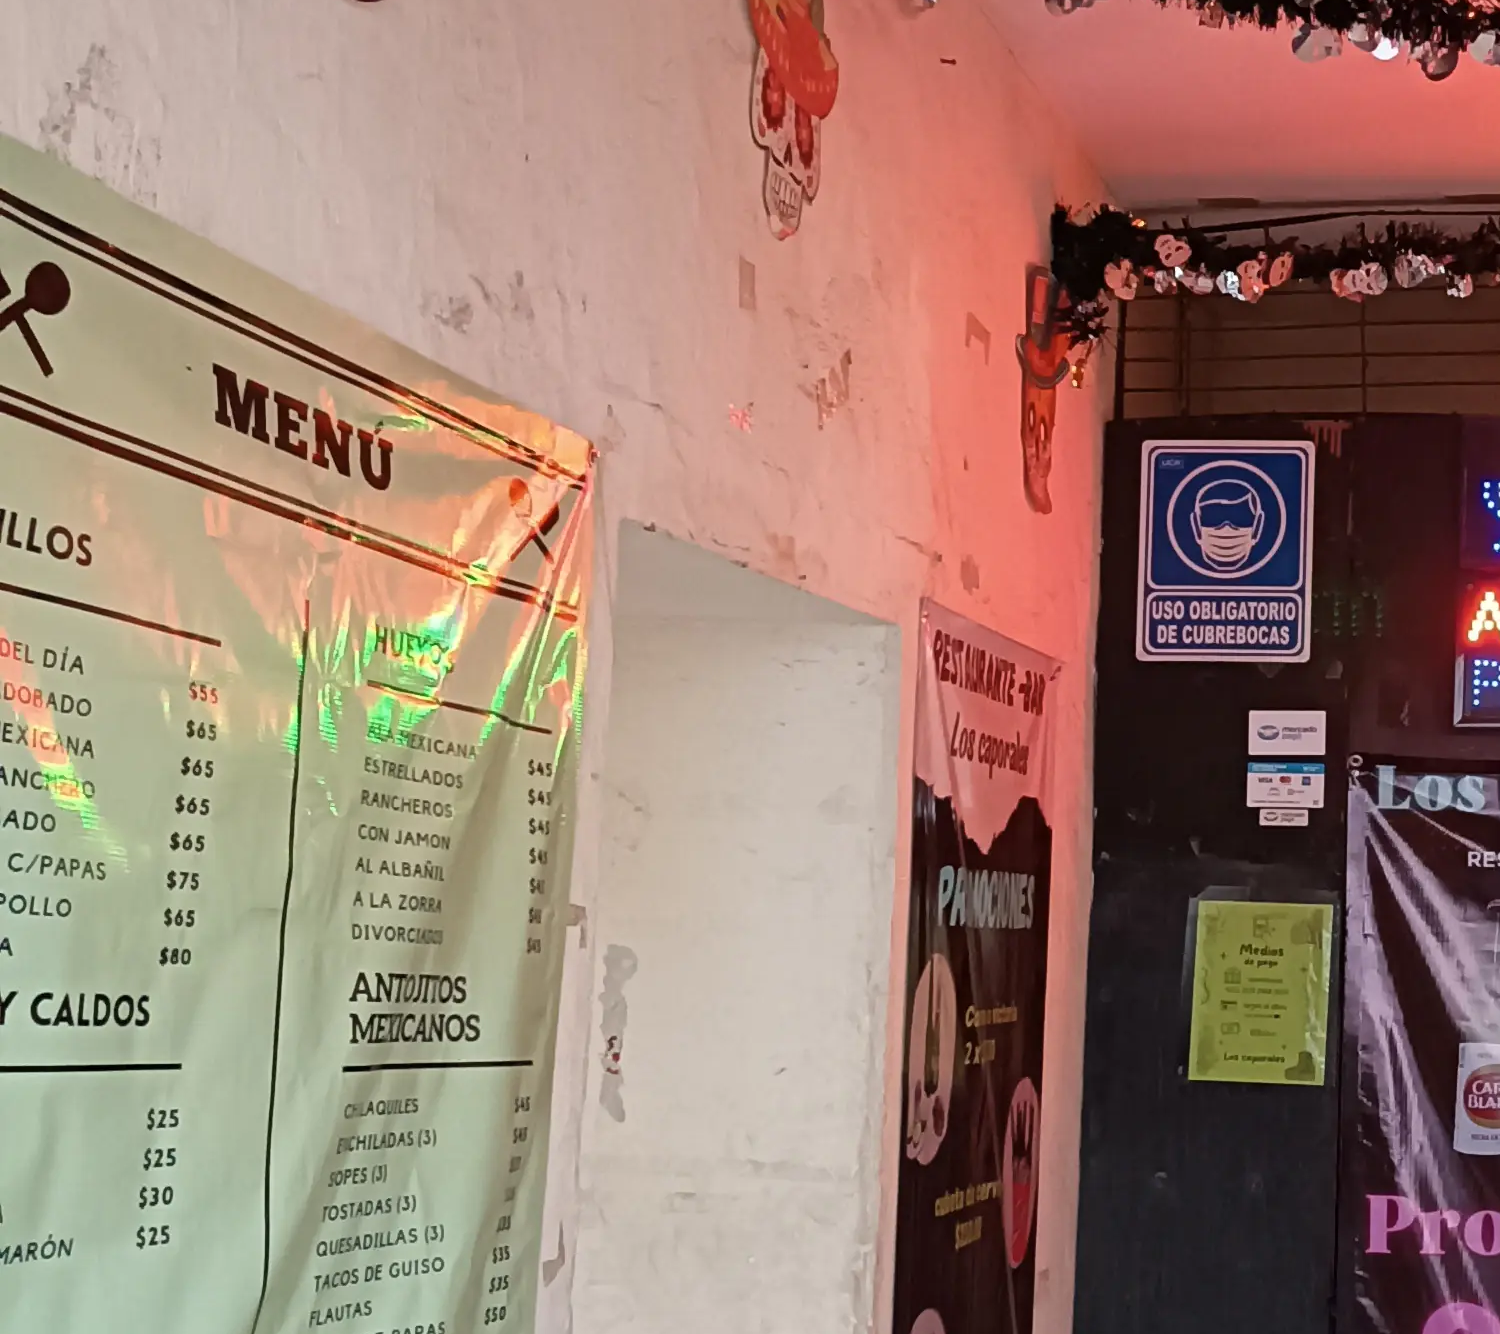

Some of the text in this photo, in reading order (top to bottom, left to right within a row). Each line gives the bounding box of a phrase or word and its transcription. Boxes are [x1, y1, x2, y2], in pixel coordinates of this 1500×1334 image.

[212, 362, 394, 491] MENÚ
[1152, 600, 1296, 622] USO OBLIGATORIO
[1156, 624, 1291, 646] DE CUBREBOCAS
[43, 646, 84, 675] DÍA
[932, 628, 1016, 708] RESTAURANTE
[0, 681, 92, 717] DOBADO
[188, 680, 219, 705] $55
[0, 722, 95, 760] EXICANA
[186, 719, 217, 742] $65
[950, 711, 1029, 780] Los caporales
[181, 756, 214, 779] $65
[364, 756, 464, 789] ESTRELLADOS
[527, 759, 553, 777] $45
[1376, 764, 1487, 814] Los
[175, 794, 210, 816] $65
[360, 789, 453, 818] RANCHEROS
[169, 831, 205, 853] $65
[357, 823, 450, 850] CON JAMON
[7, 852, 107, 881] C/PAPAS
[355, 857, 445, 882] AL ALBAÑIL
[166, 870, 200, 891] $75
[353, 891, 442, 914] A LA ZORRA
[163, 907, 196, 928] $65
[159, 947, 192, 967] $80
[1240, 943, 1284, 957] Medios
[348, 972, 467, 1004] ANTOJITOS
[30, 992, 150, 1027] CALDOS
[349, 1013, 481, 1045] MEXICANOS
[146, 1108, 180, 1131] $25
[343, 1097, 419, 1120] CHLAQUILES
[336, 1128, 438, 1155] ECHILADAS (3)
[143, 1147, 177, 1171] $25
[327, 1166, 367, 1188] SOPES
[139, 1186, 174, 1210] $30
[321, 1194, 417, 1223] TOSTADAS (3)
[136, 1225, 170, 1250] $25
[316, 1223, 445, 1258] QUESADILLAS (3)
[314, 1256, 445, 1293] TACOS DE GUISO
[308, 1300, 373, 1329] FLAUTAS
